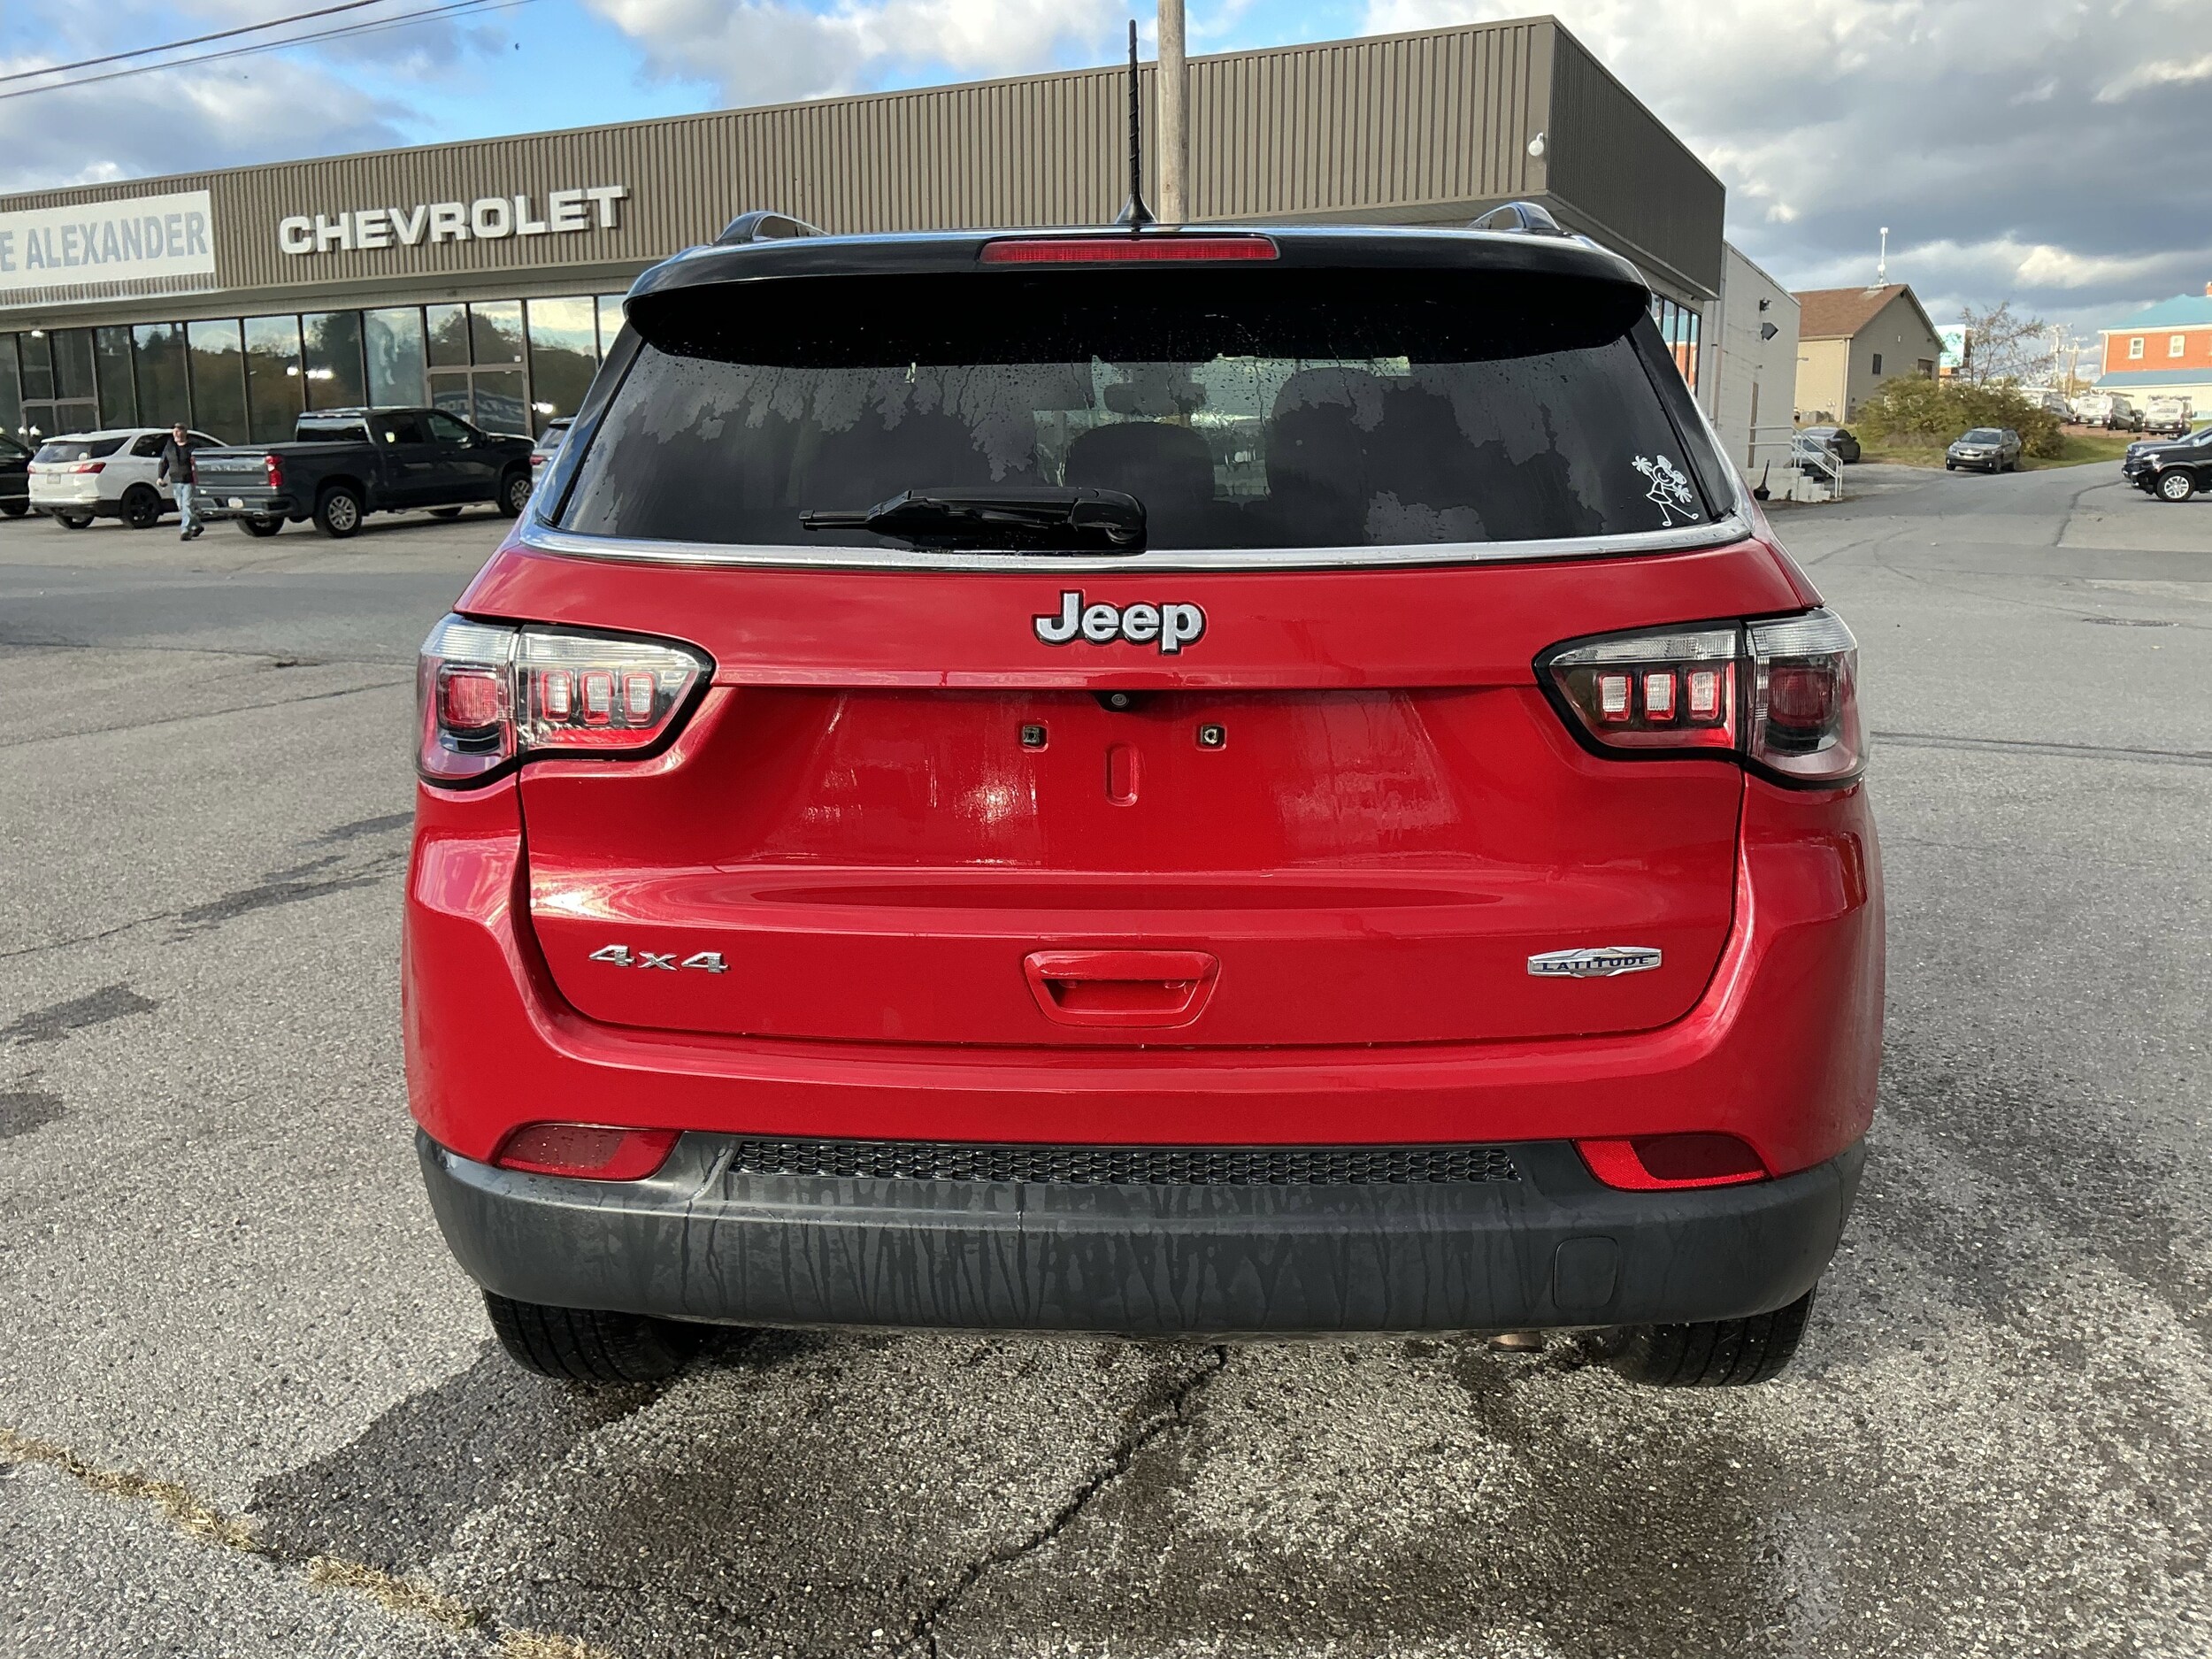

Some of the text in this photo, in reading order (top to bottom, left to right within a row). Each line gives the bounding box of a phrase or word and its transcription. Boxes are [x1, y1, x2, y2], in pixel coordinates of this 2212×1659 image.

[26, 211, 208, 270] ALEXANDER
[279, 185, 628, 255] CHEVROLET
[1033, 590, 1205, 654] Jeep
[588, 943, 729, 973] 4x4
[1541, 955, 1651, 972] LATITUDE
